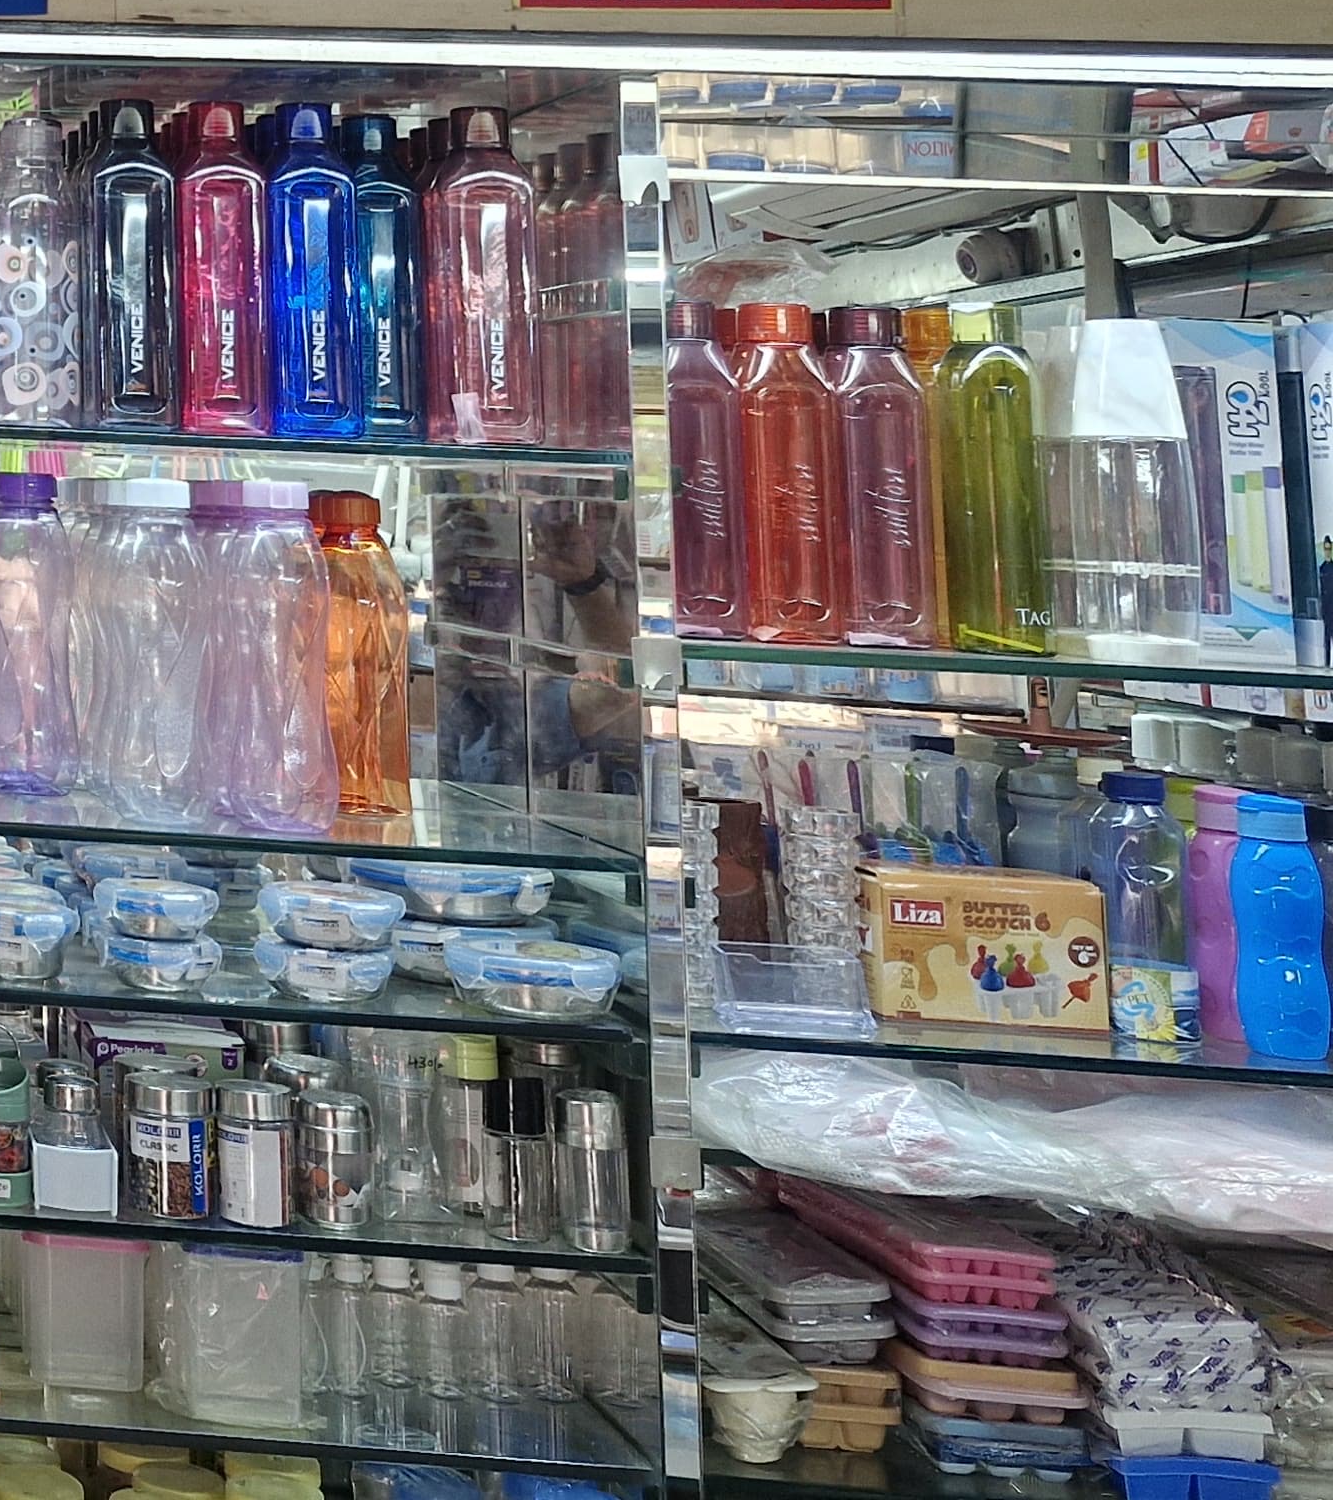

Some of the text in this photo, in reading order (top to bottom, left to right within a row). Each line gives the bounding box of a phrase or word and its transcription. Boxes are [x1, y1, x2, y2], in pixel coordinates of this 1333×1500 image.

[221, 309, 234, 380] VENICE
[378, 318, 391, 387] VENICE
[1016, 608, 1051, 625] TAG
[893, 902, 943, 925] Liza
[962, 901, 1032, 916] BUTTER
[963, 916, 1031, 930] SCOTCH
[193, 1133, 203, 1196] KOLORR
